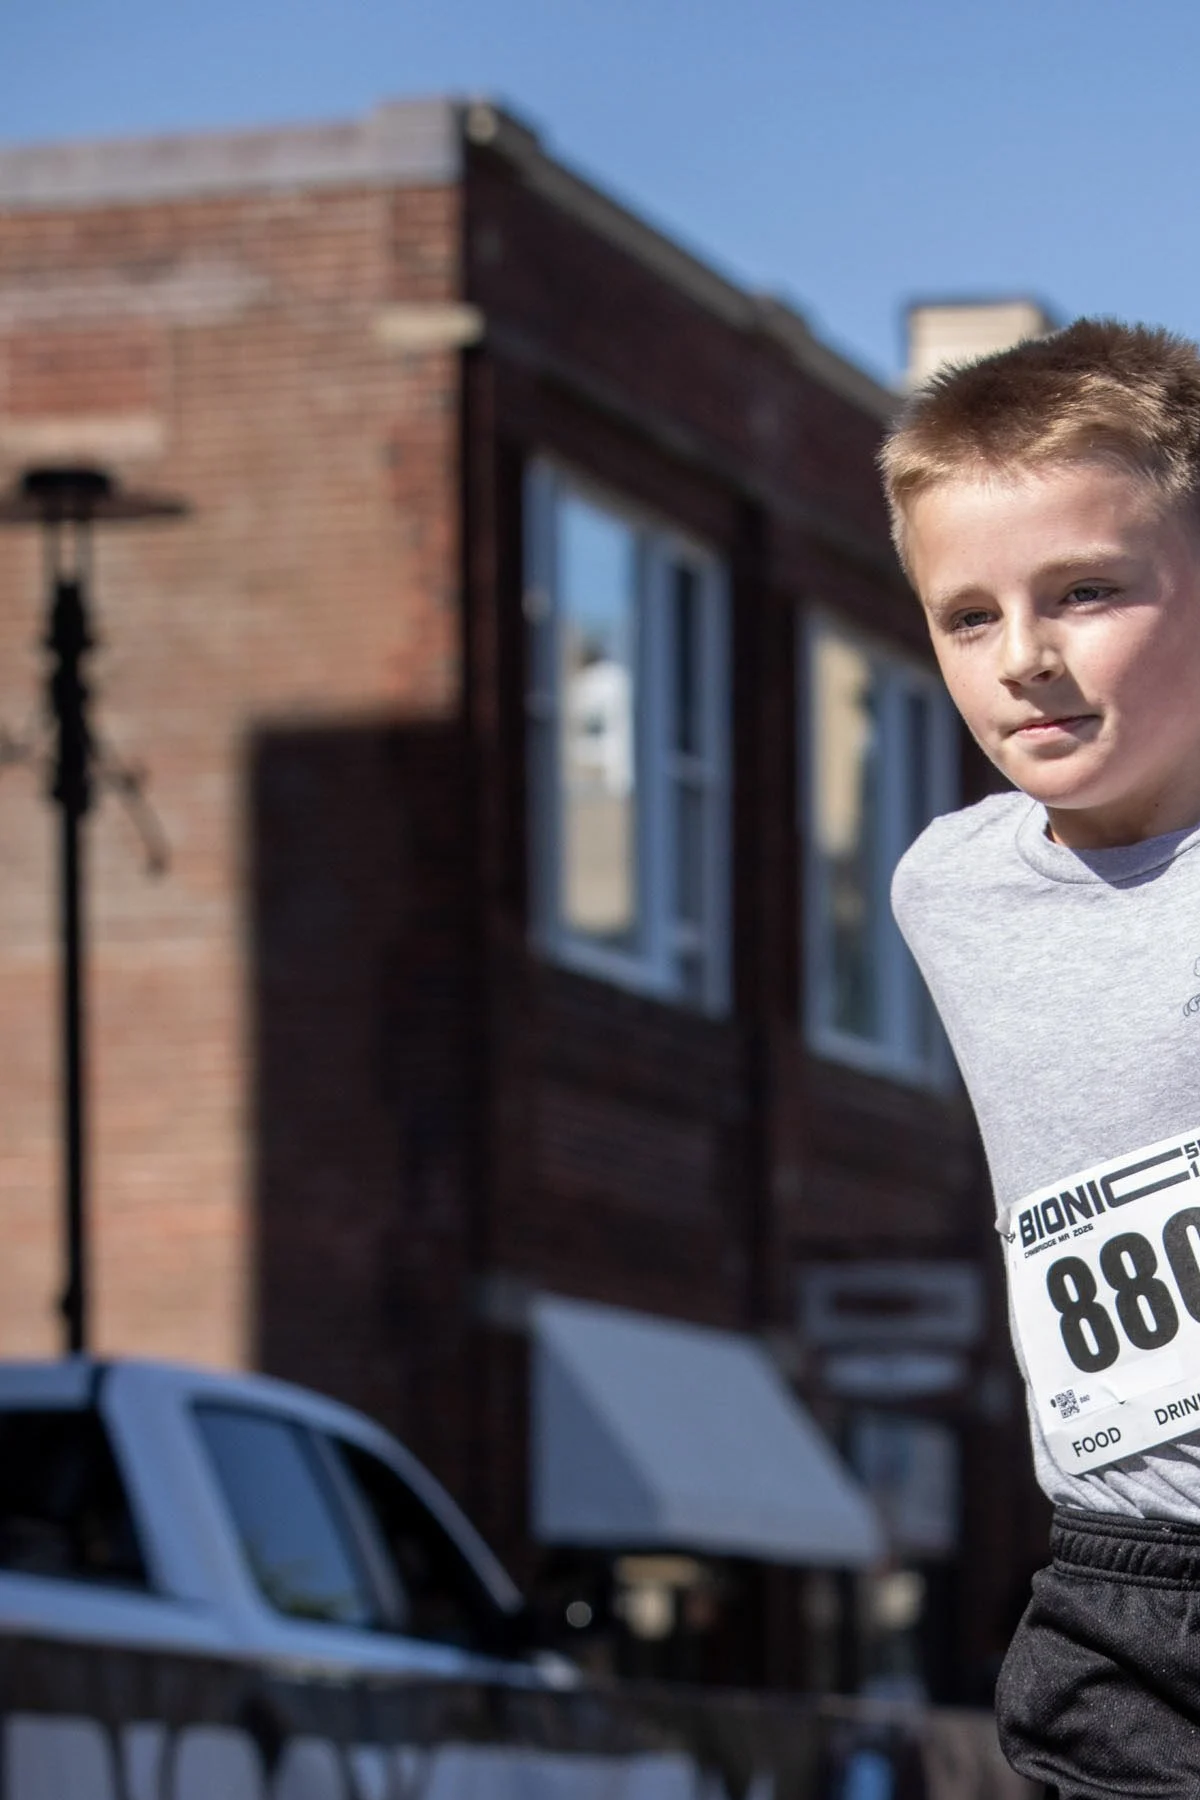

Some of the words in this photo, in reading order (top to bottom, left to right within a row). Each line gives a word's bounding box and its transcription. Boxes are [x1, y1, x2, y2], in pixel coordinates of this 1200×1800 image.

[1018, 1146, 1192, 1249] BIONIC
[1058, 1233, 1070, 1243] MA
[1073, 1223, 1094, 1238] 2026
[1072, 1427, 1122, 1458] FOOD
